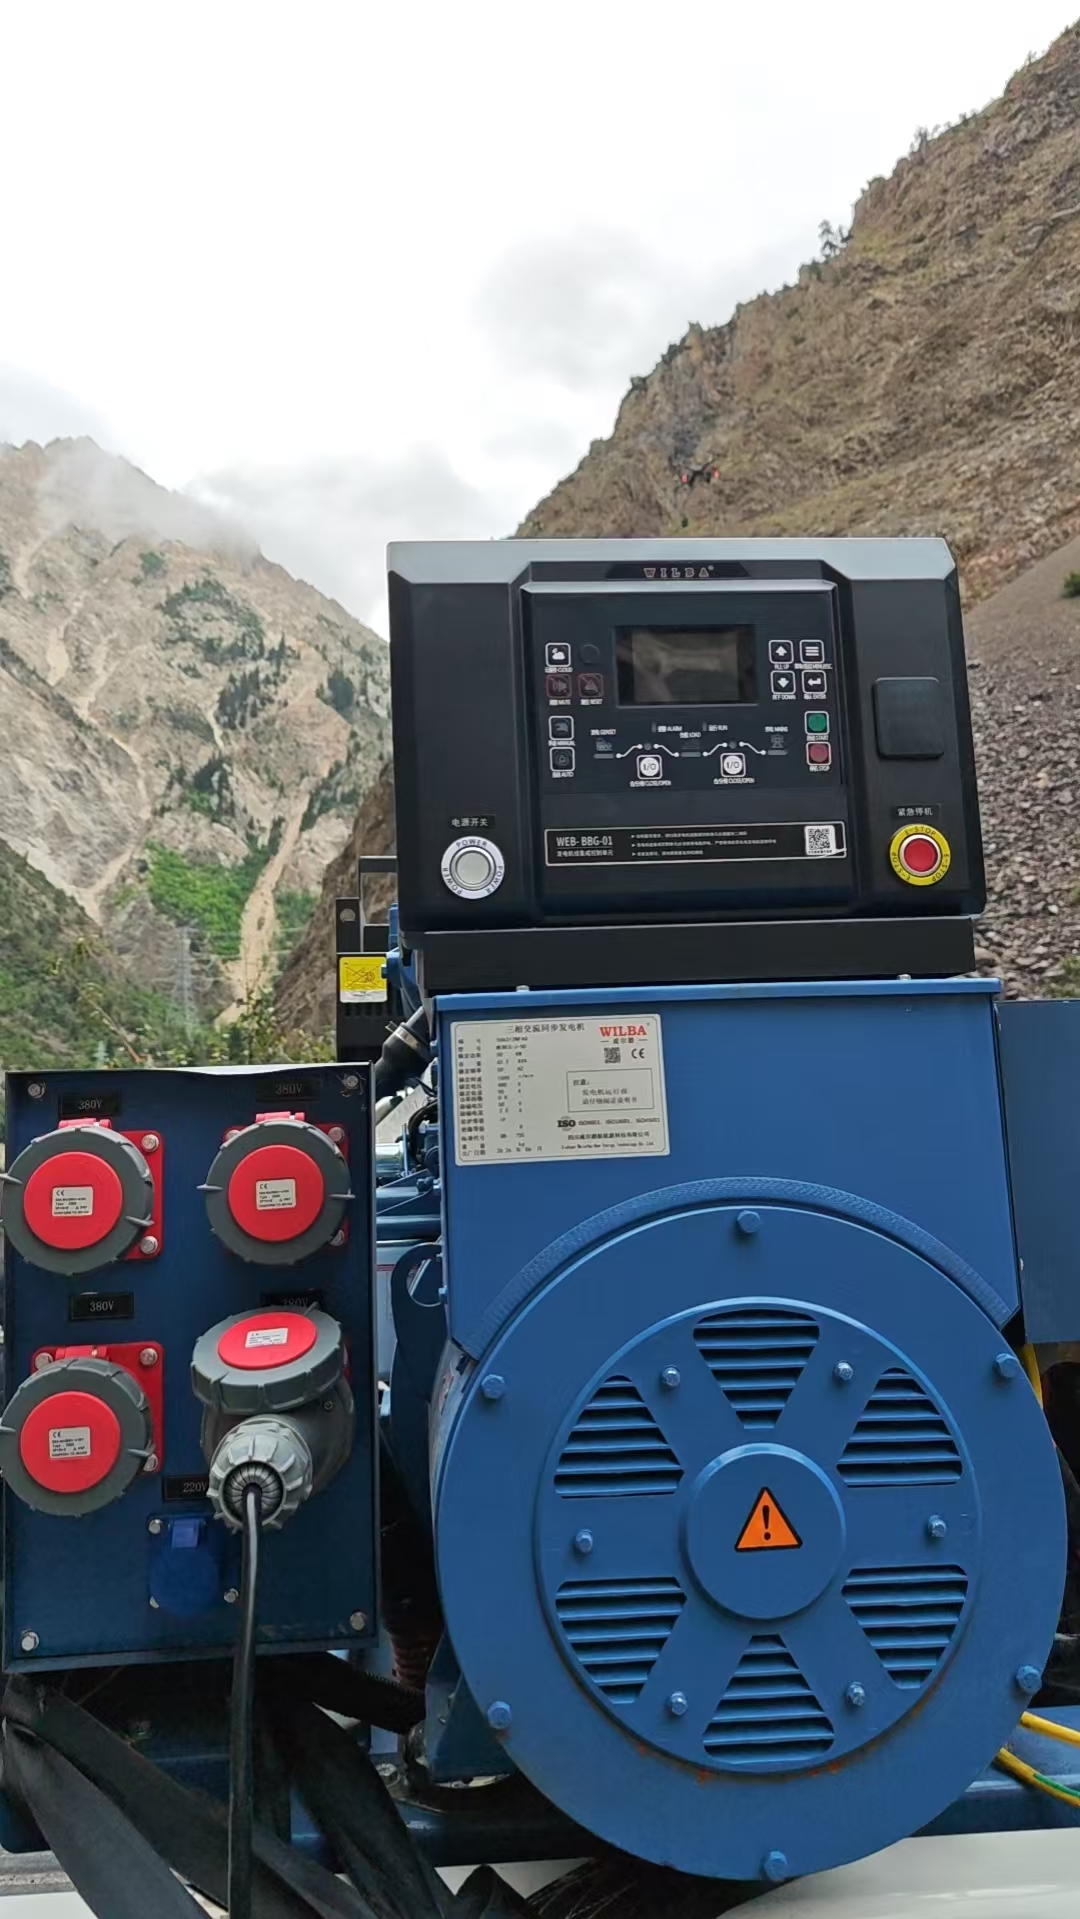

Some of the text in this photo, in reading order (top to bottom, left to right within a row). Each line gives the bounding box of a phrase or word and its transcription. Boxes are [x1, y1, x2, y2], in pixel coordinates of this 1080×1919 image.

[897, 807, 933, 817] 紧急停机
[451, 817, 488, 828] 电源开关
[456, 839, 488, 847] POWER
[581, 835, 613, 846] BBG-01
[599, 1024, 647, 1037] WILBA
[276, 1083, 304, 1095] 380V
[79, 1099, 103, 1110] 380V
[557, 1119, 576, 1128] ISO
[89, 1300, 115, 1312] 380V
[183, 1481, 207, 1493] 220V
